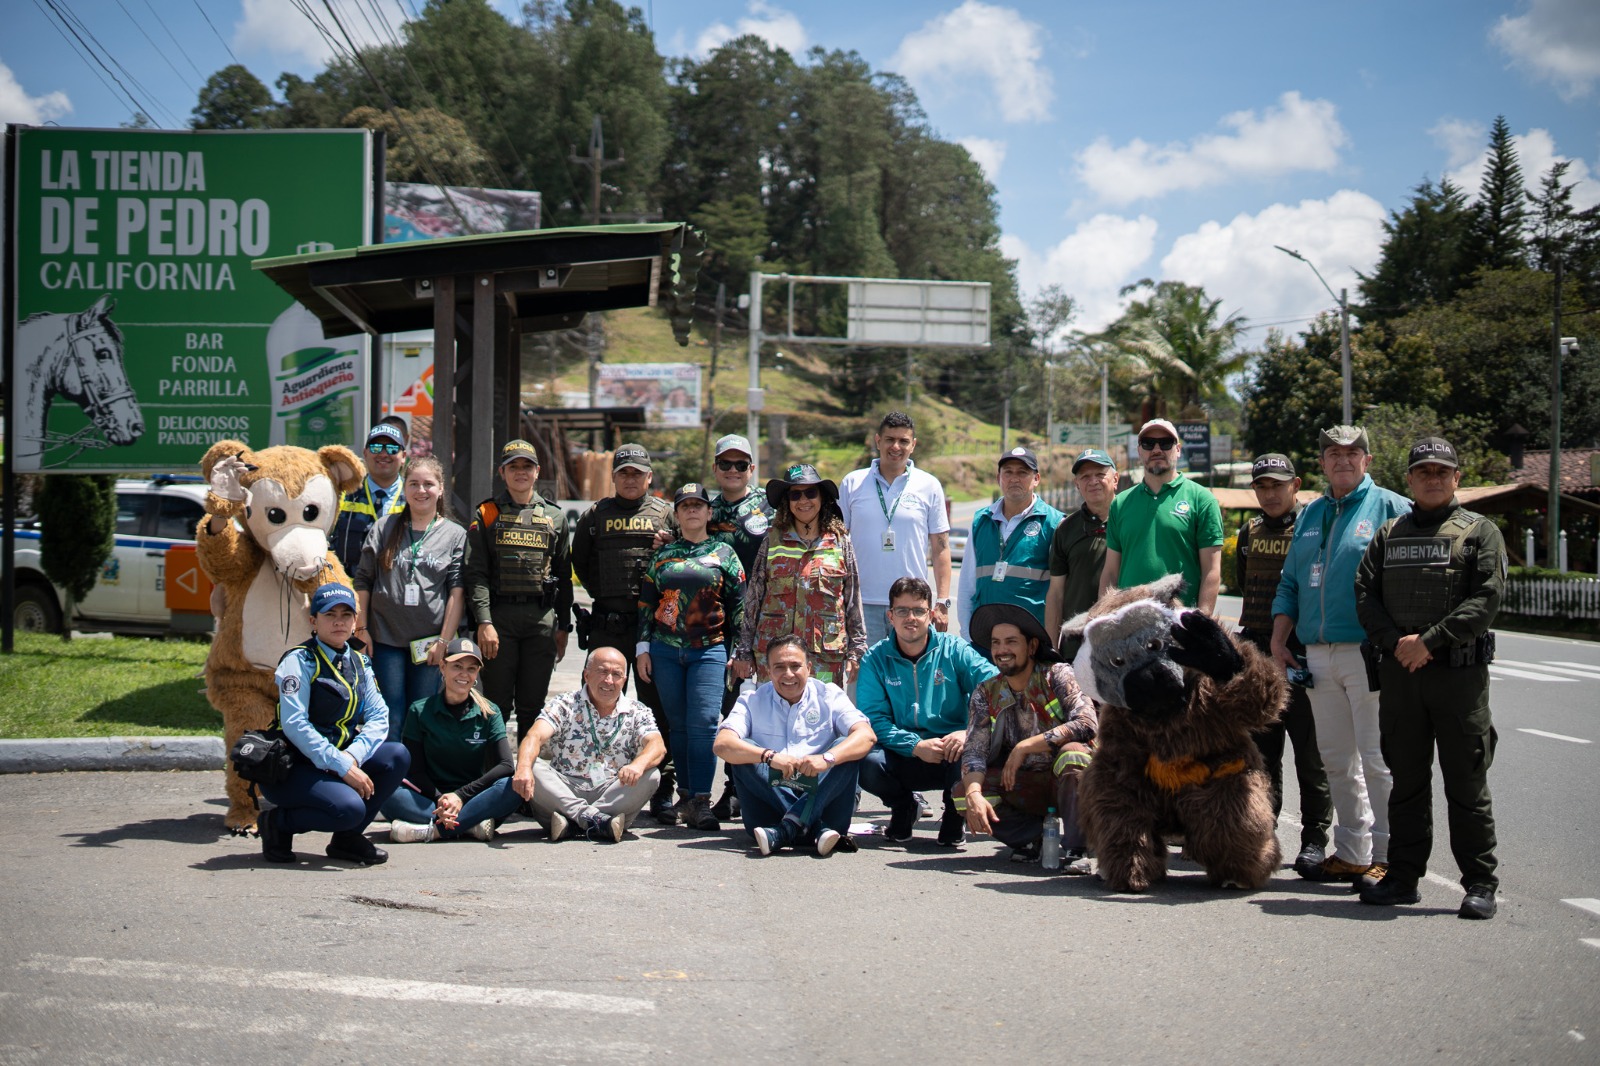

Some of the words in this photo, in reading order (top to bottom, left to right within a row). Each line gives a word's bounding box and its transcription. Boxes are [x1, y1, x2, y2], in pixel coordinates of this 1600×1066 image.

[40, 149, 81, 190] LA
[91, 150, 206, 192] TIENDA
[40, 196, 99, 255] DE
[116, 198, 270, 257] PEDRO
[40, 261, 236, 290] CALIFORNIA
[185, 332, 224, 350] BAR
[171, 355, 237, 373] FONDA
[281, 361, 353, 394] Aguardiente
[158, 379, 250, 397] PARRILLA
[281, 371, 354, 407] Antioqueño
[157, 415, 250, 431] DELICIOSOS
[503, 531, 543, 543] POLICÍA
[1386, 544, 1449, 561] AMBIENTAL
